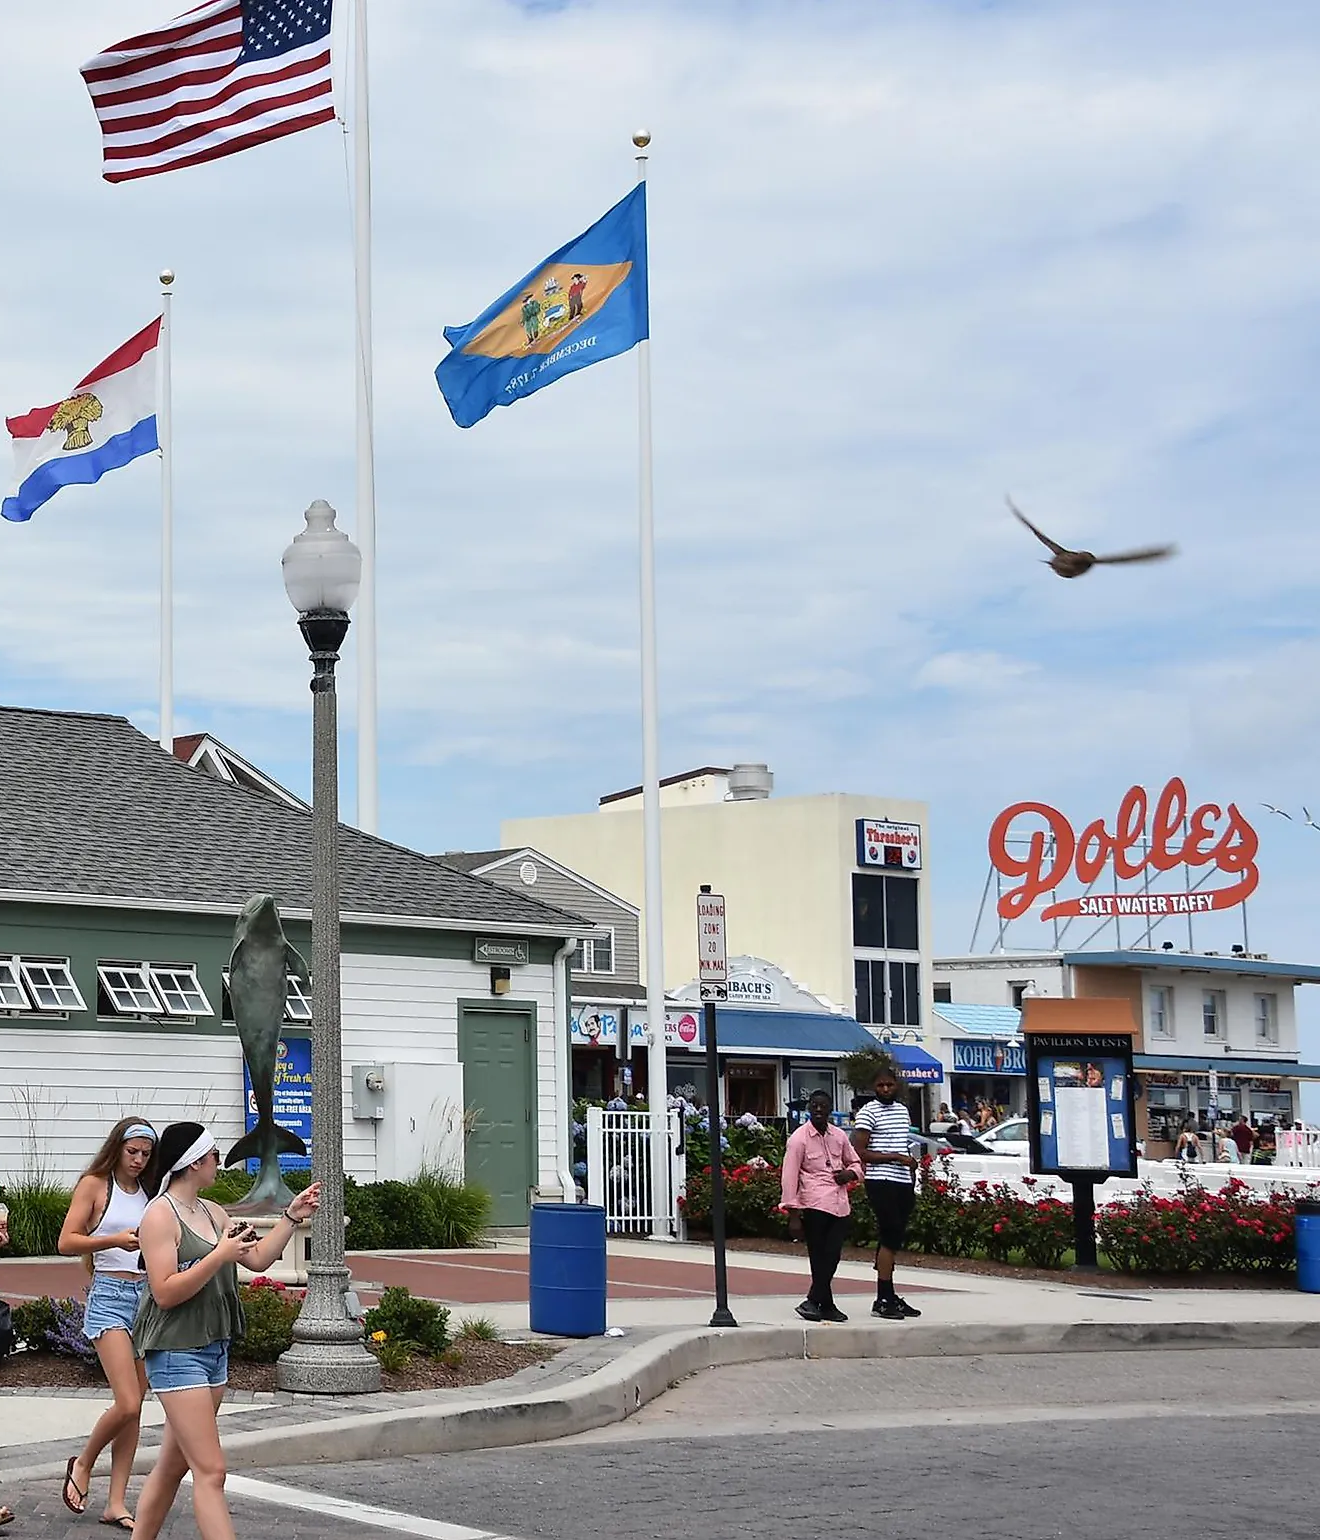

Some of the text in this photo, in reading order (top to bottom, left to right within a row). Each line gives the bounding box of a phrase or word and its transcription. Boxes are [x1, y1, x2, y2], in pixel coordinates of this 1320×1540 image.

[866, 828, 918, 846] Thrasher's
[698, 904, 724, 916] LOADING
[1079, 894, 1215, 915] SALT WATER TAFFY
[703, 923, 720, 935] ZONE
[708, 941, 717, 953] 20
[728, 982, 772, 995] IBACH'S
[1033, 1036, 1128, 1047] PAVILLION EVENTS
[955, 1045, 1026, 1069] KOHR BR
[895, 1067, 940, 1079] hrasher's
[273, 1105, 298, 1113] OKE-FREE
